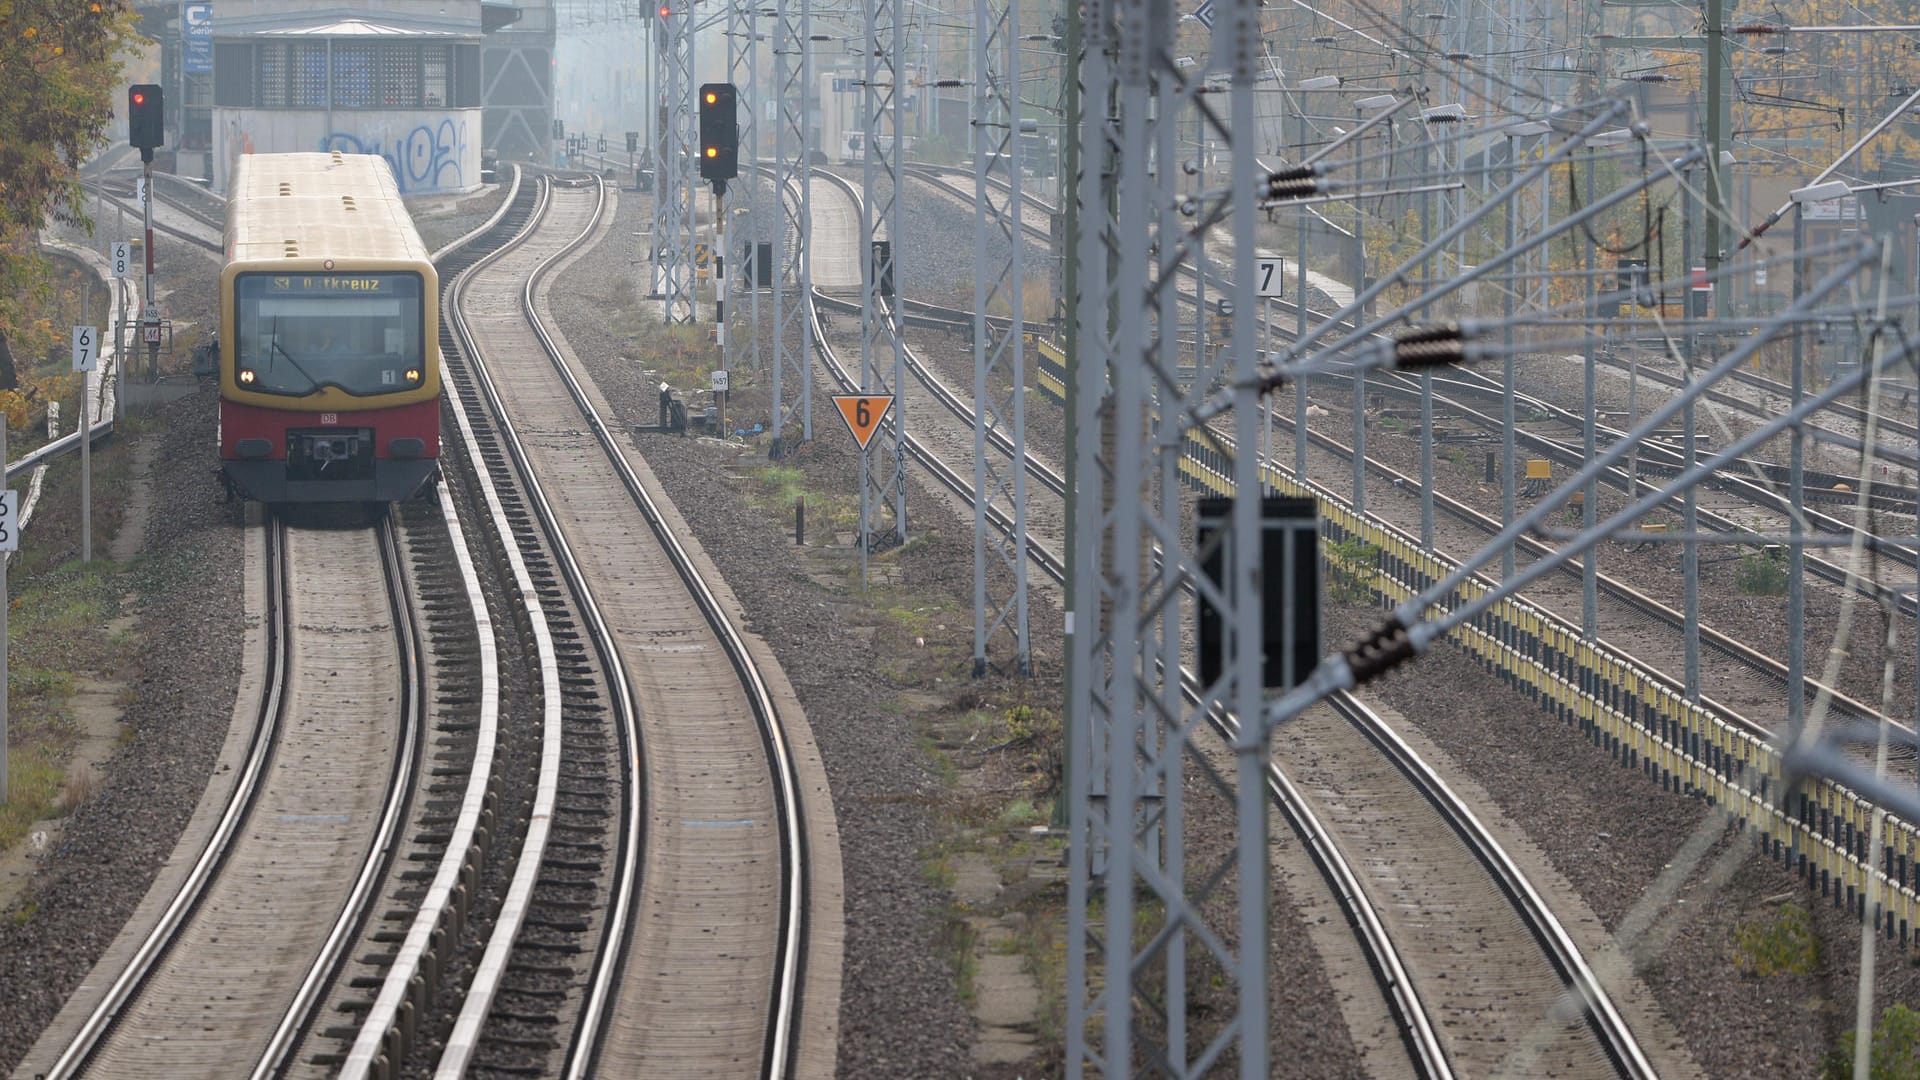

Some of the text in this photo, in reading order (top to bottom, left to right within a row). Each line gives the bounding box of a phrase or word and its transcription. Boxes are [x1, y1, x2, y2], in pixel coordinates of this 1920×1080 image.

[1261, 263, 1274, 291] 7
[323, 414, 336, 423] DB
[856, 399, 870, 428] 6
